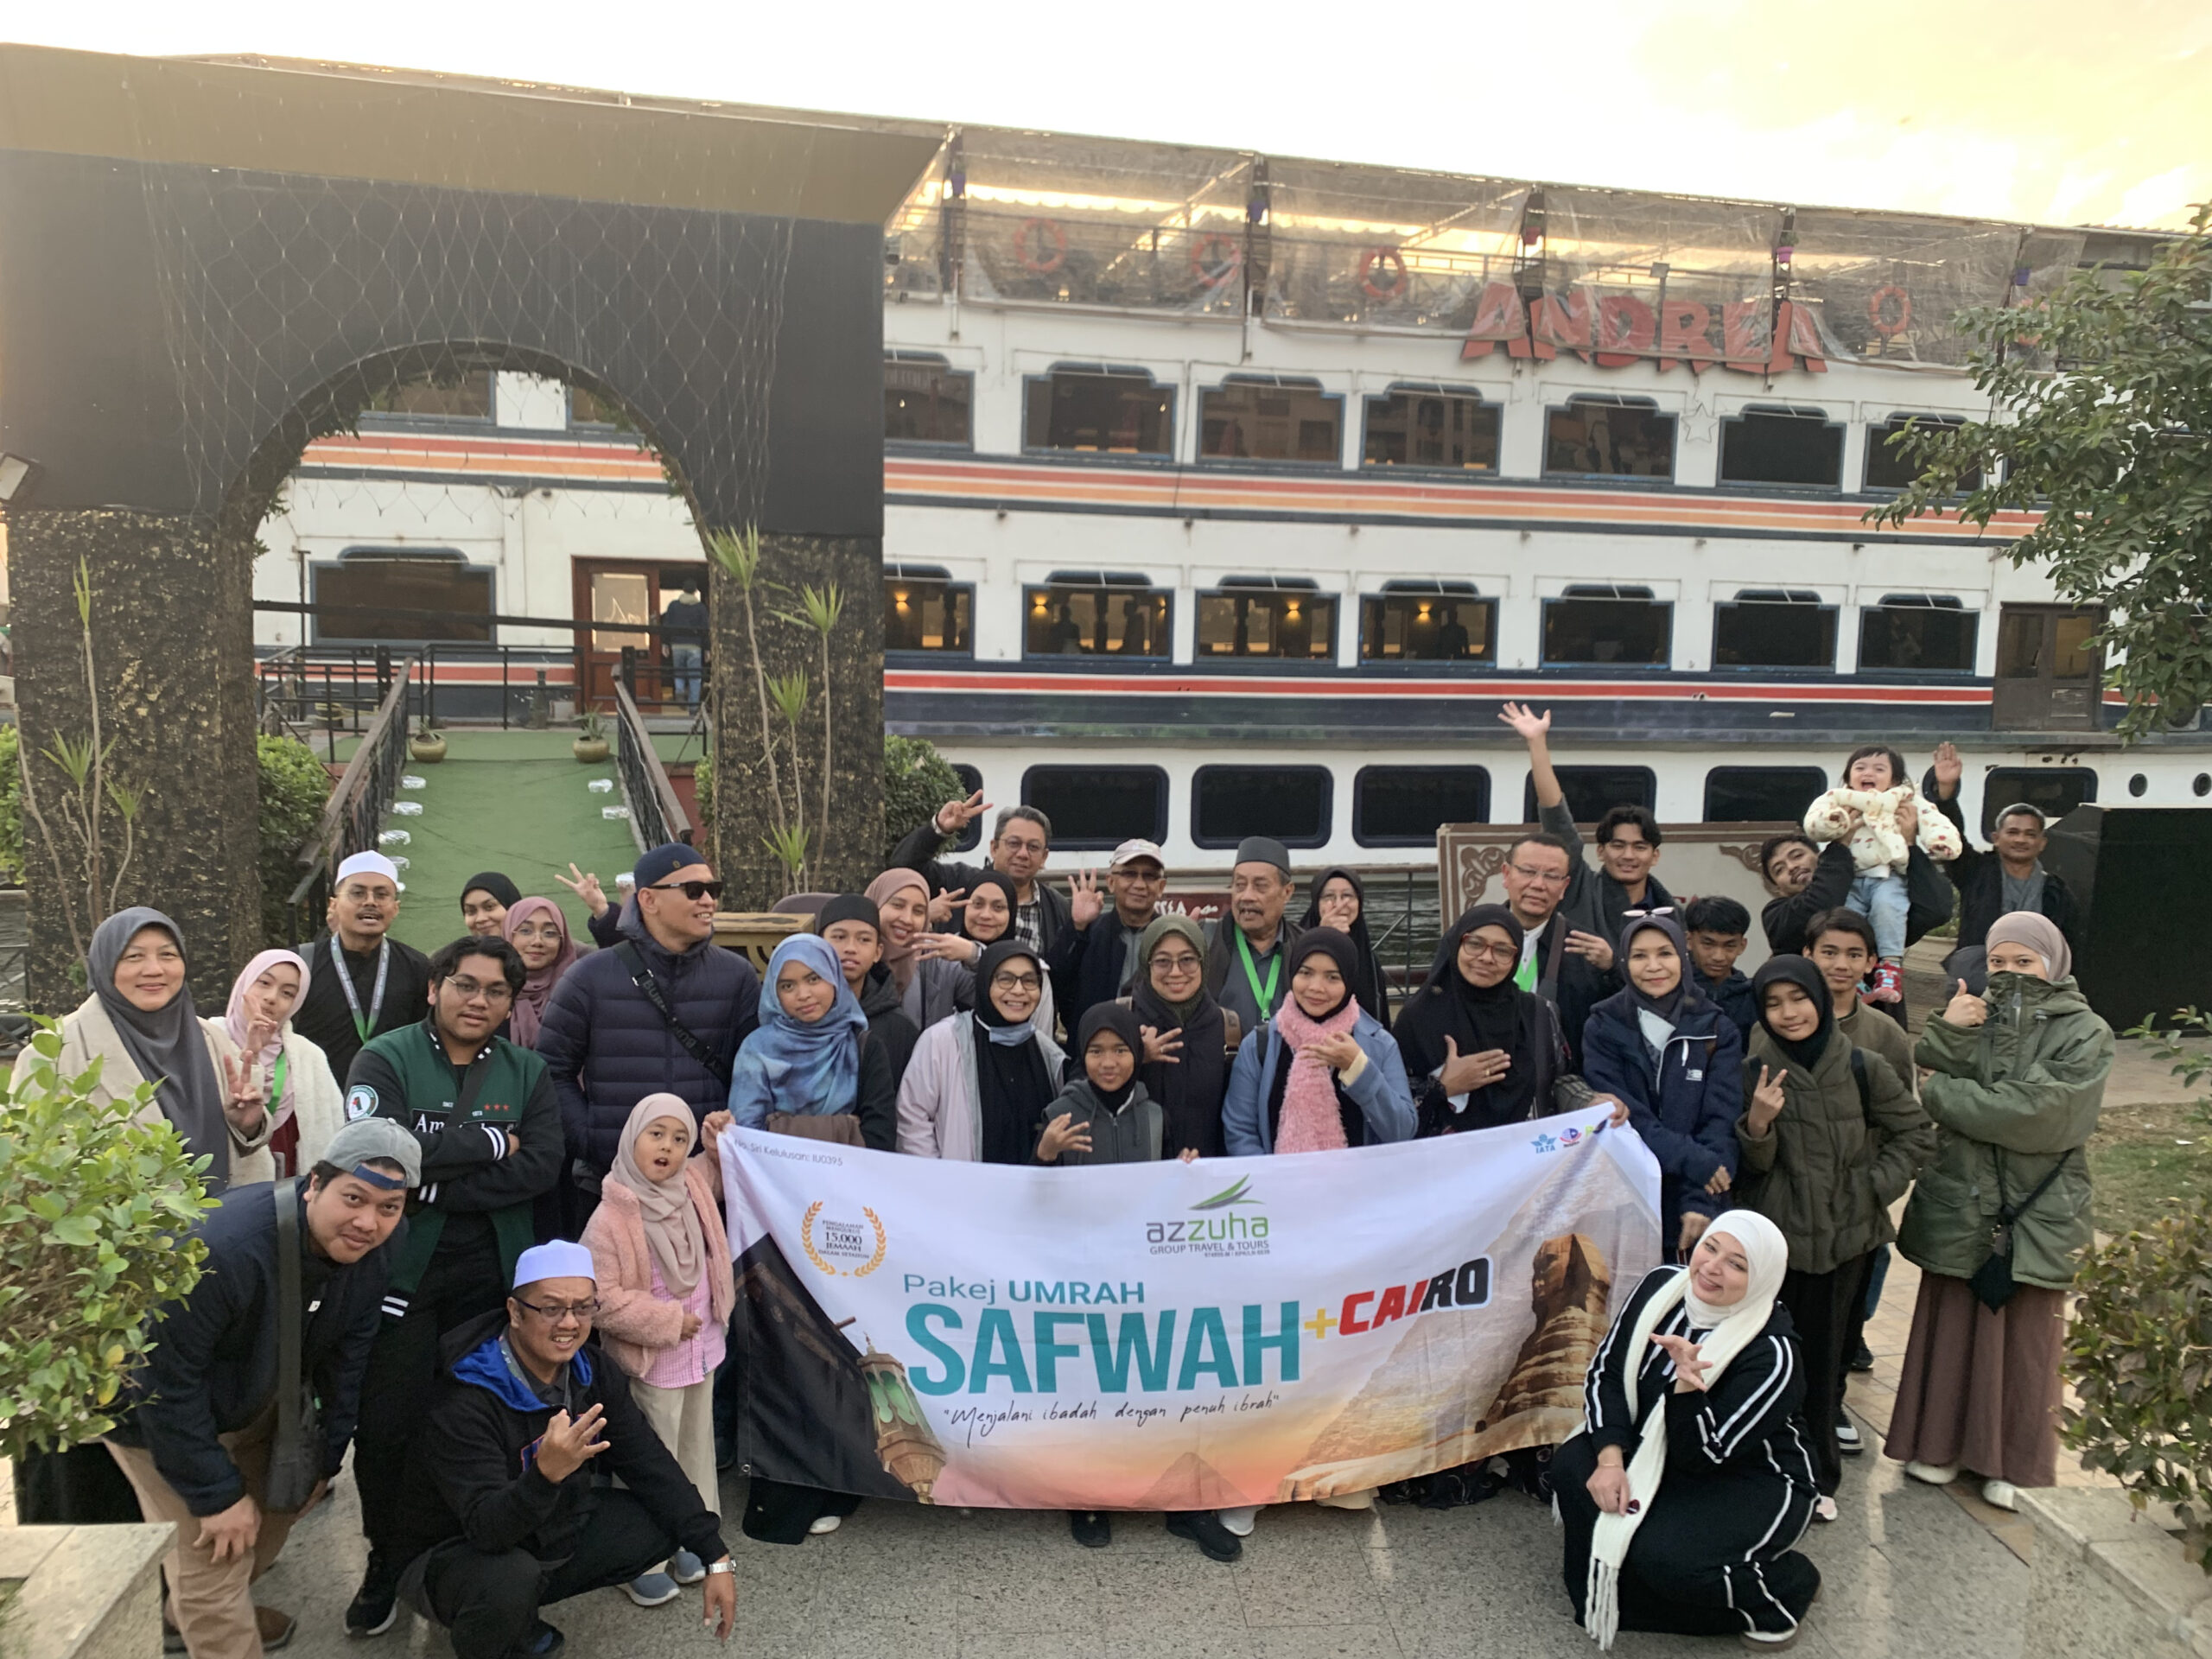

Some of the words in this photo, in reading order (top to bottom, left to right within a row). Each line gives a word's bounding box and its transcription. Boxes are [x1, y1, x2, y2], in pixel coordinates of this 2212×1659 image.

[1461, 281, 1827, 375] ANDREA
[1535, 1144, 1555, 1154] IATA
[1146, 1211, 1268, 1244] azzuha
[1150, 1244, 1186, 1255] GROUP
[1189, 1242, 1223, 1252] TRAVEL
[1227, 1242, 1235, 1251] &
[1236, 1240, 1269, 1251] TOURS
[904, 1274, 995, 1305] Pakej
[1008, 1281, 1144, 1304] UMRAH
[906, 1300, 1300, 1396] SAFWAH
[1339, 1258, 1489, 1336] CAIRO
[1043, 1402, 1097, 1421] ibadah
[1115, 1402, 1166, 1427] dengan
[1179, 1396, 1224, 1422] penuh
